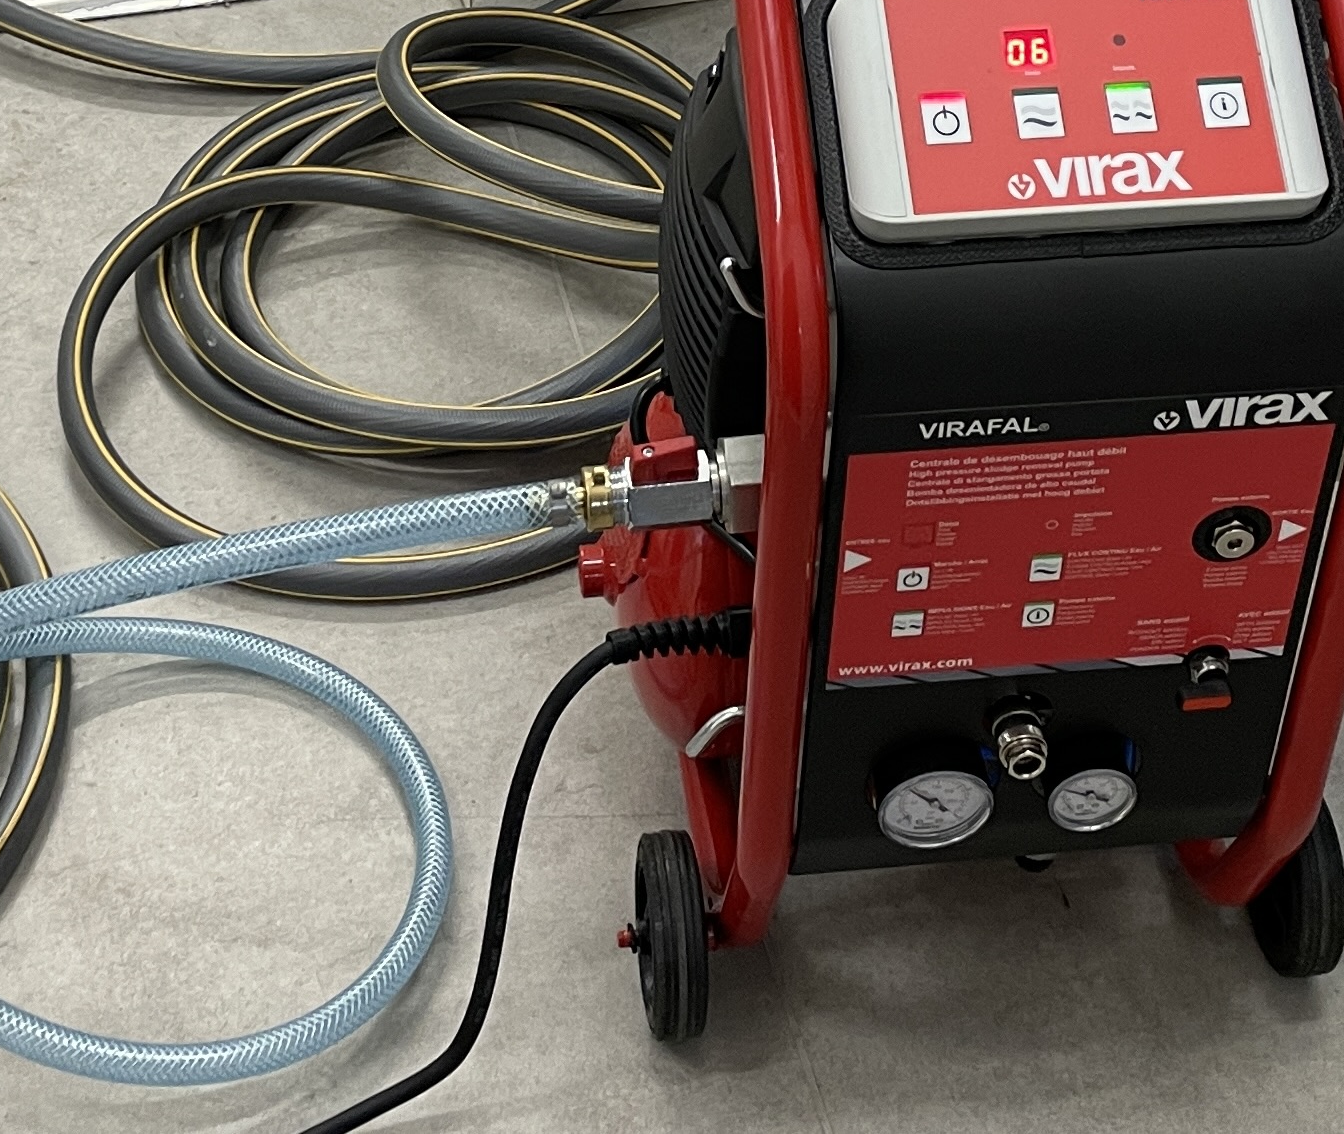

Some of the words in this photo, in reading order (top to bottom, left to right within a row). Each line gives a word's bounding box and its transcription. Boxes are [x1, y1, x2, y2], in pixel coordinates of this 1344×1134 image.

[1007, 37, 1049, 67] 06
[1033, 150, 1193, 199] virax
[1185, 390, 1334, 429] virax
[919, 416, 1039, 440] VIRAFAL
[963, 456, 977, 465] de
[1067, 449, 1094, 458] haut
[838, 657, 973, 676] www.virax.com
